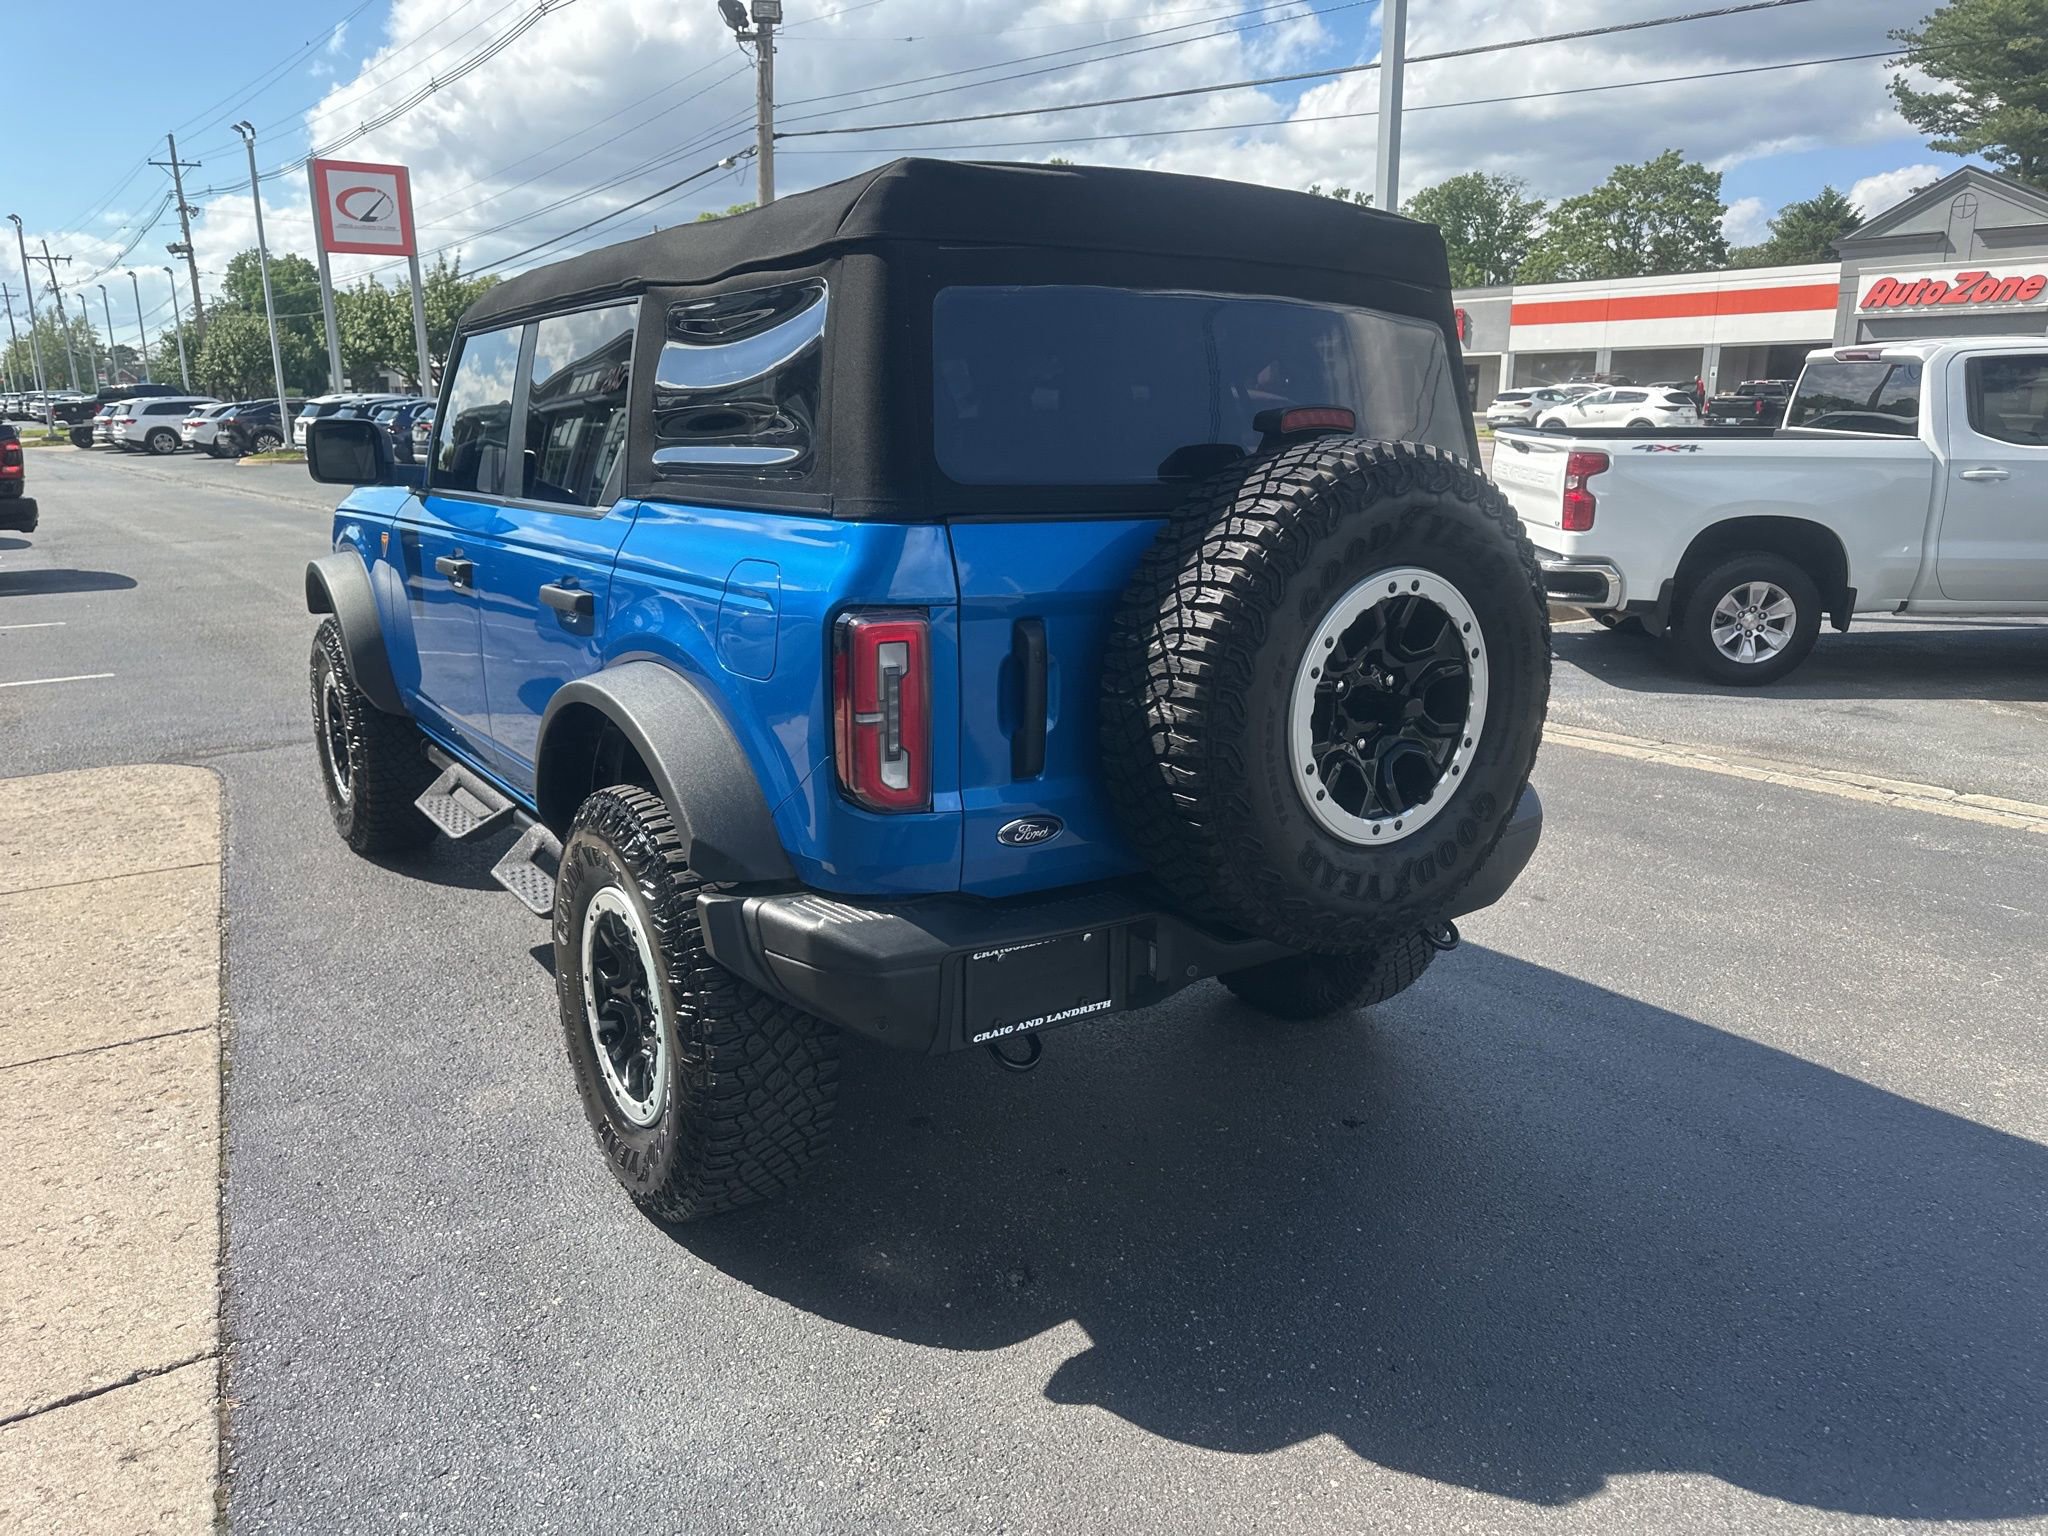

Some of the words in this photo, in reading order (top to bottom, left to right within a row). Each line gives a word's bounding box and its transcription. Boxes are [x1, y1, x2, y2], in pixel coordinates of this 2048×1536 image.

[1859, 270, 2048, 310] AutoZone
[1014, 823, 1049, 843] Ford
[973, 1026, 1014, 1043] CRAIG
[1016, 1017, 1044, 1031] AND
[1046, 1000, 1111, 1023] LANDRETH
